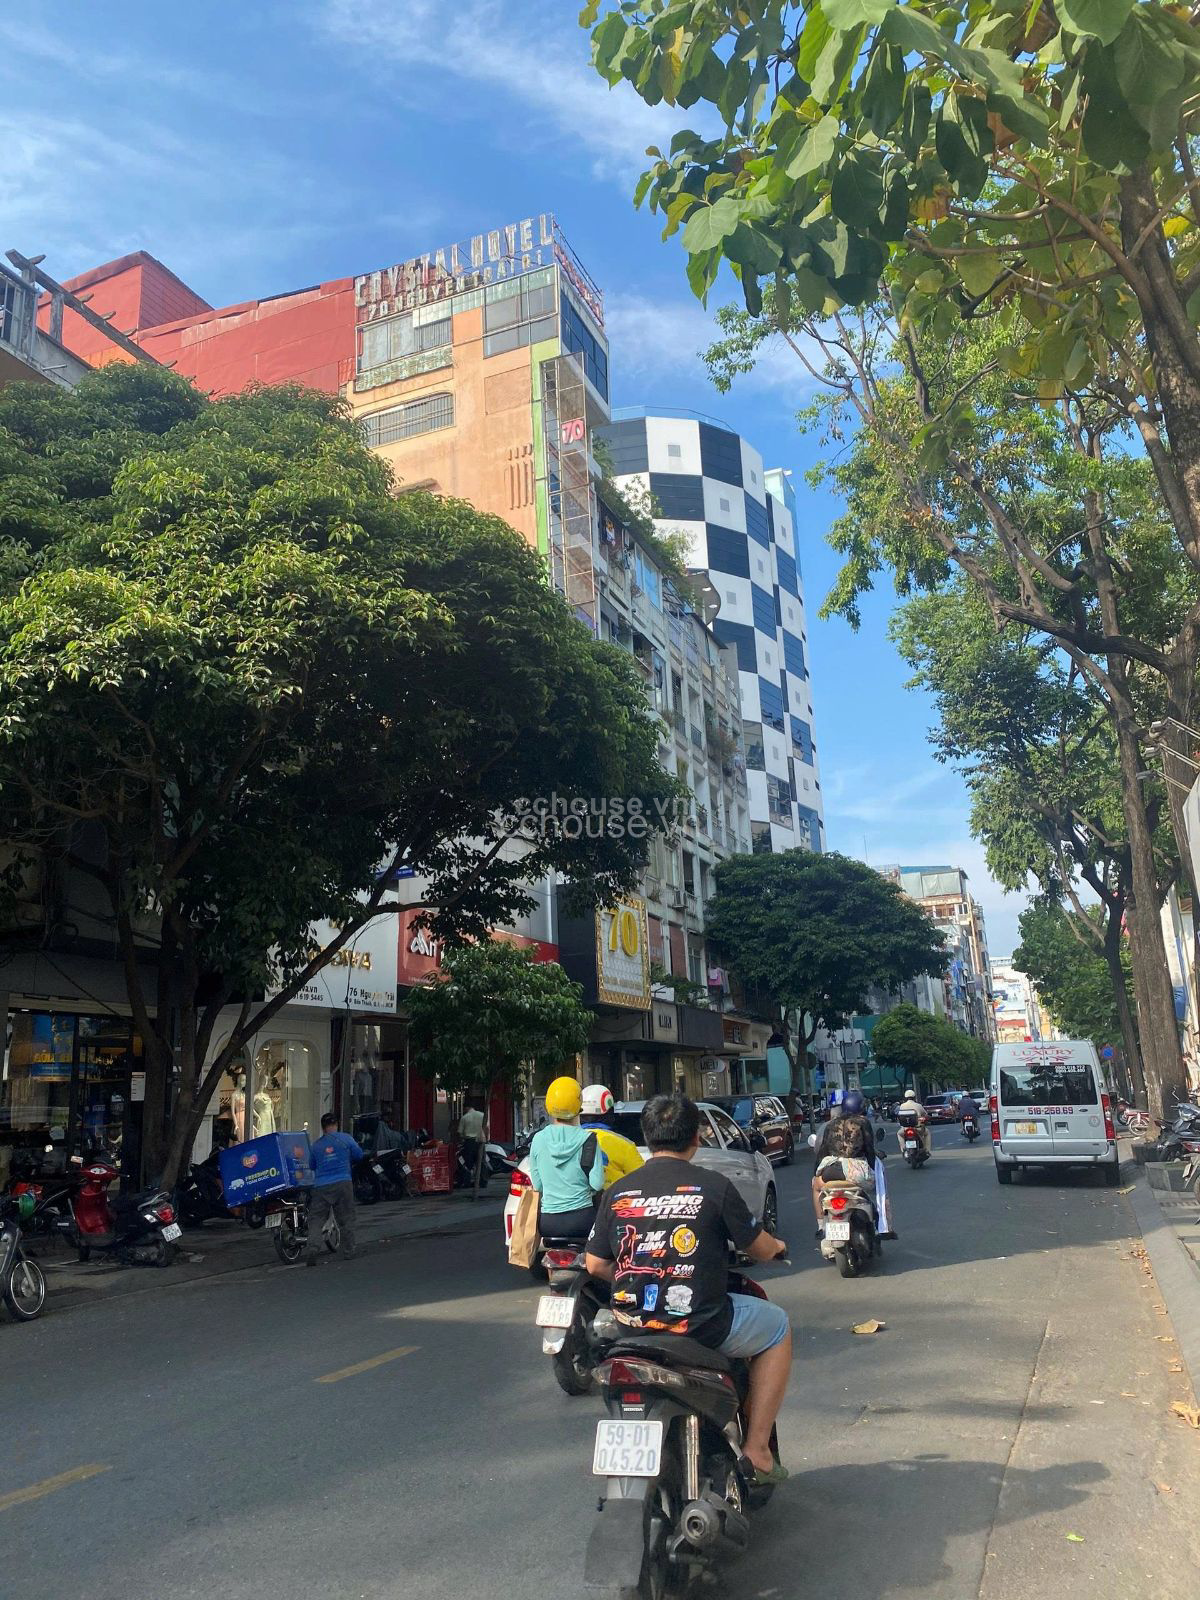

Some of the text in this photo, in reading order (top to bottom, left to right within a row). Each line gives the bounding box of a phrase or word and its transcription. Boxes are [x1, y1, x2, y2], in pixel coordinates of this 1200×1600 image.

[471, 213, 553, 268] HOTEL
[561, 419, 584, 444] 70
[603, 908, 639, 957] 70
[1011, 1049, 1073, 1057] LUXURY
[631, 1194, 704, 1208] RACING
[606, 1424, 650, 1447] 59-D1
[598, 1448, 657, 1471] 045.20
